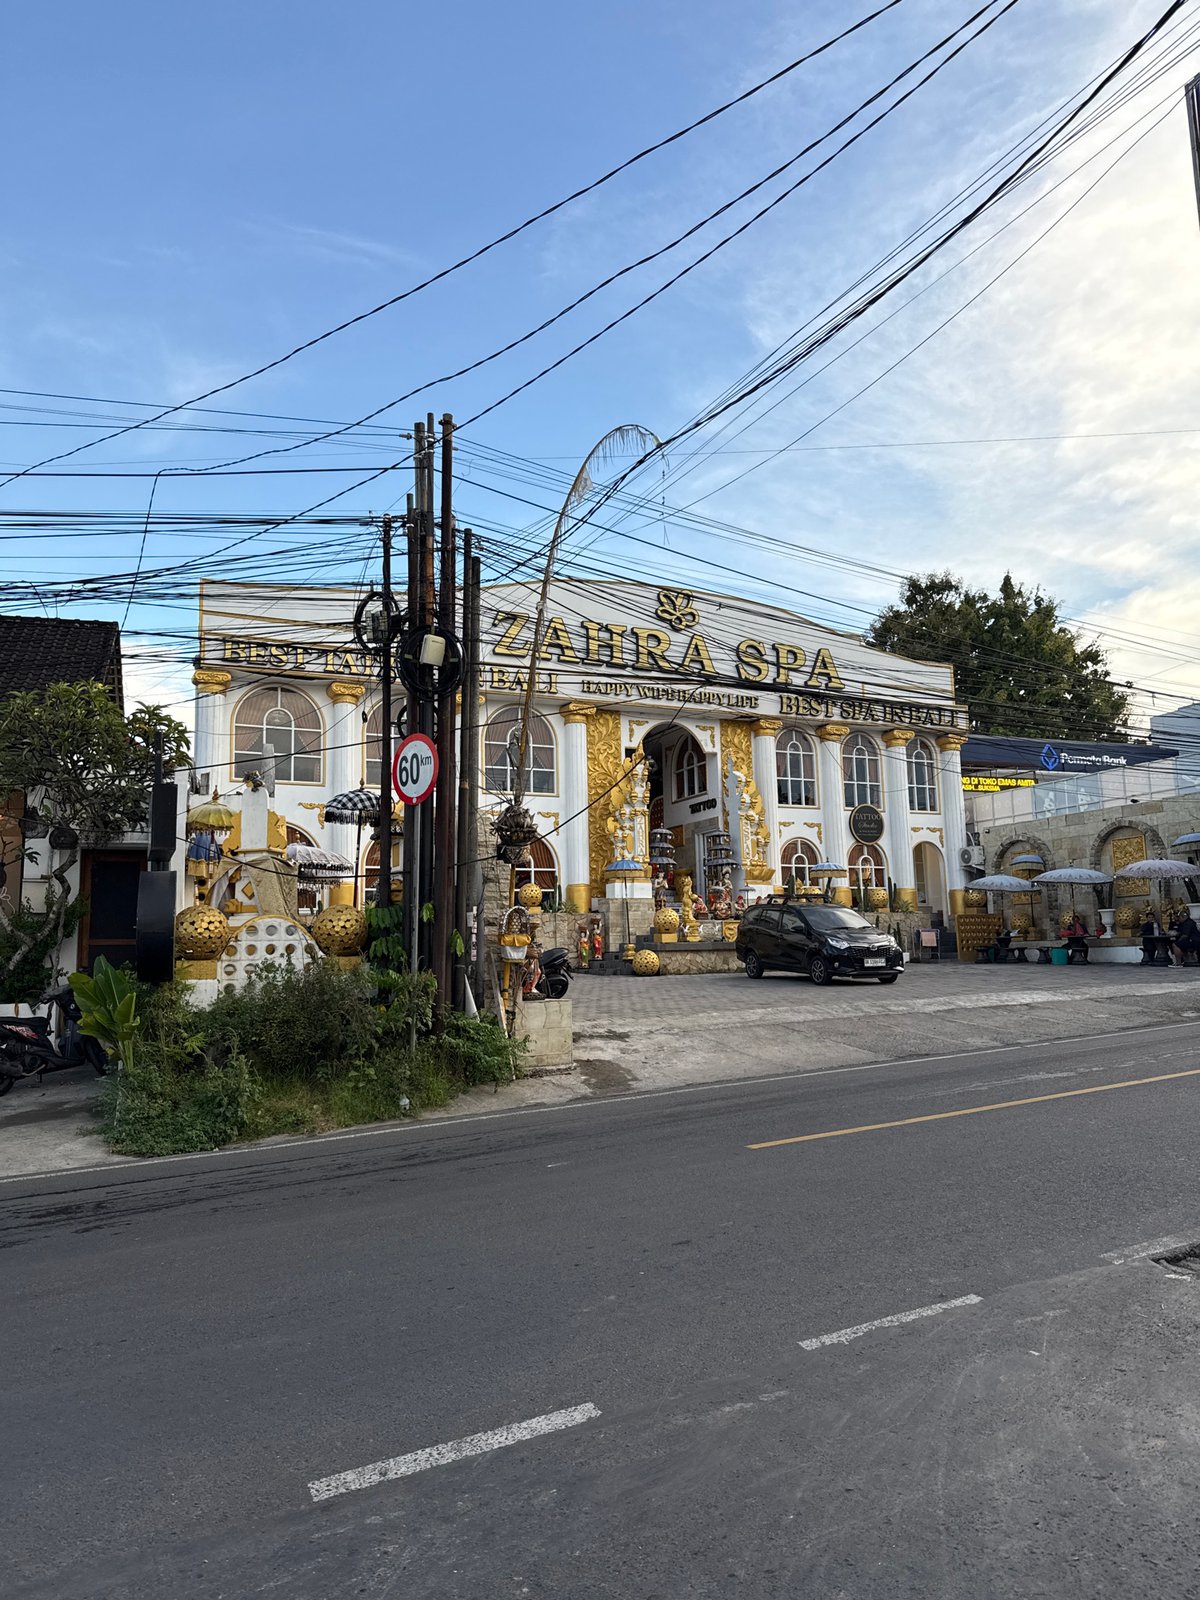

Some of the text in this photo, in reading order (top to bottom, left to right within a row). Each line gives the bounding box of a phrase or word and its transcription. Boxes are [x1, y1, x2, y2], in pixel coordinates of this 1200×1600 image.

[222, 639, 311, 670] BEST
[492, 610, 846, 689] ZAHRA SPA
[490, 666, 559, 694] BALI
[583, 680, 760, 709] HAPPY WIFE HAPPY LIFE
[780, 694, 837, 718] BEST
[839, 700, 879, 722] SPA
[399, 753, 420, 787] 60
[855, 813, 882, 821] TATTOO
